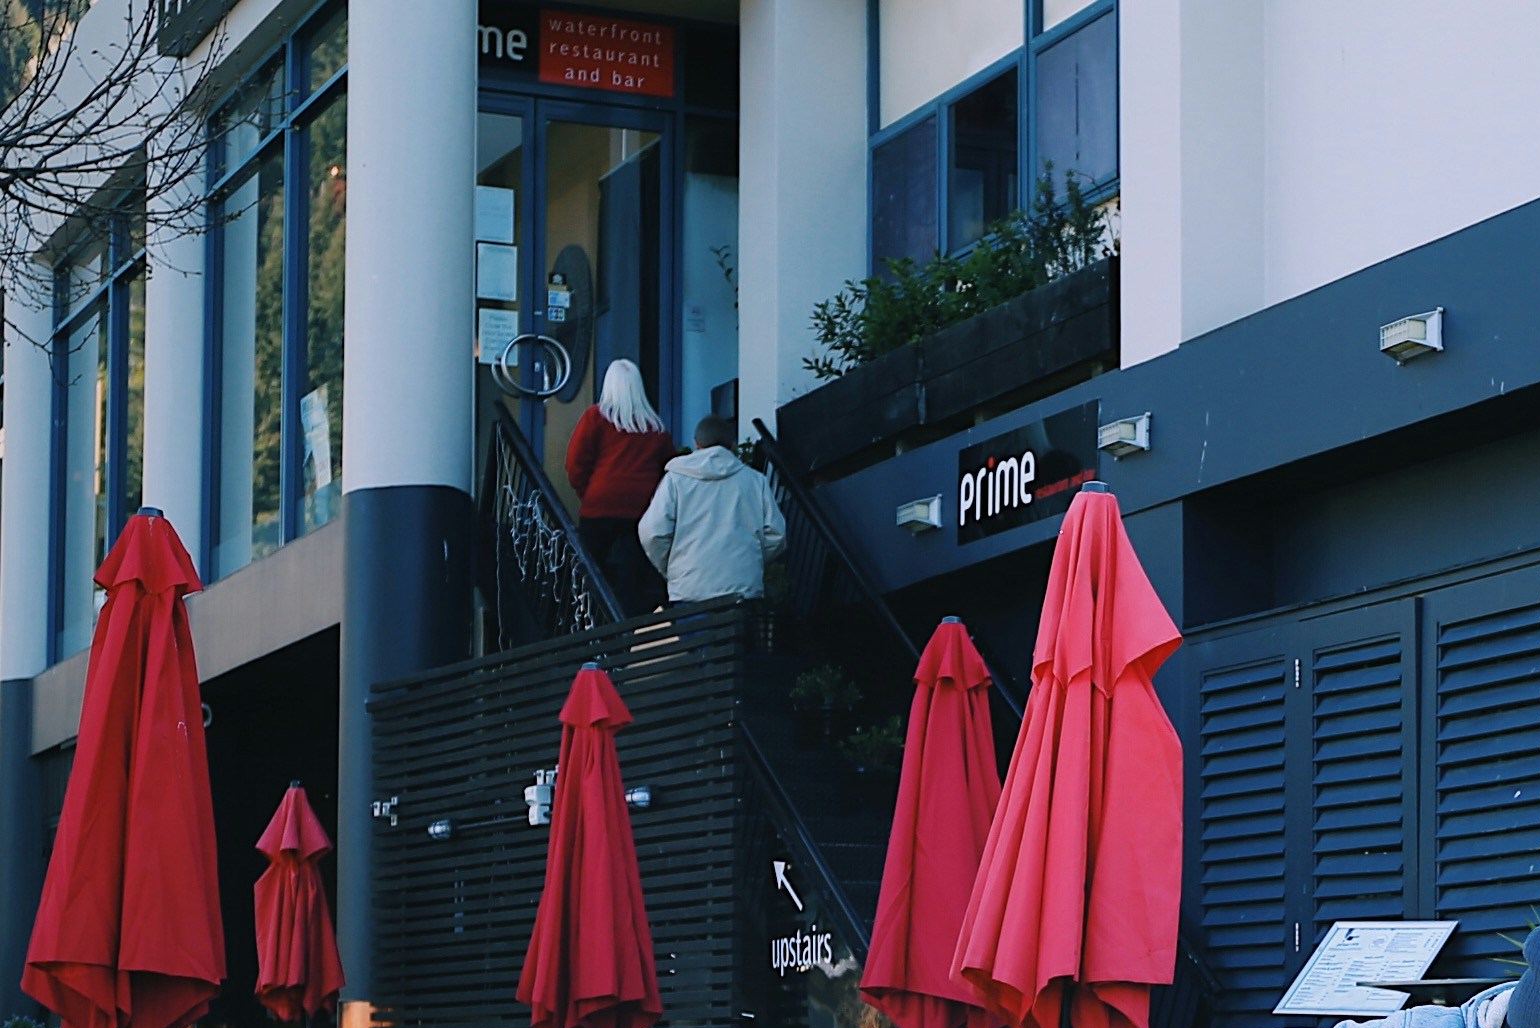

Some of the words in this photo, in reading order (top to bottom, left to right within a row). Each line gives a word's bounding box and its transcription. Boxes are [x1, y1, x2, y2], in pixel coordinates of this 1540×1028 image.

[549, 18, 662, 45] waterfront
[549, 41, 660, 68] restaurant
[564, 66, 600, 83] and
[612, 70, 646, 89] bar
[960, 451, 1035, 526] prime
[771, 924, 832, 977] upstairs
